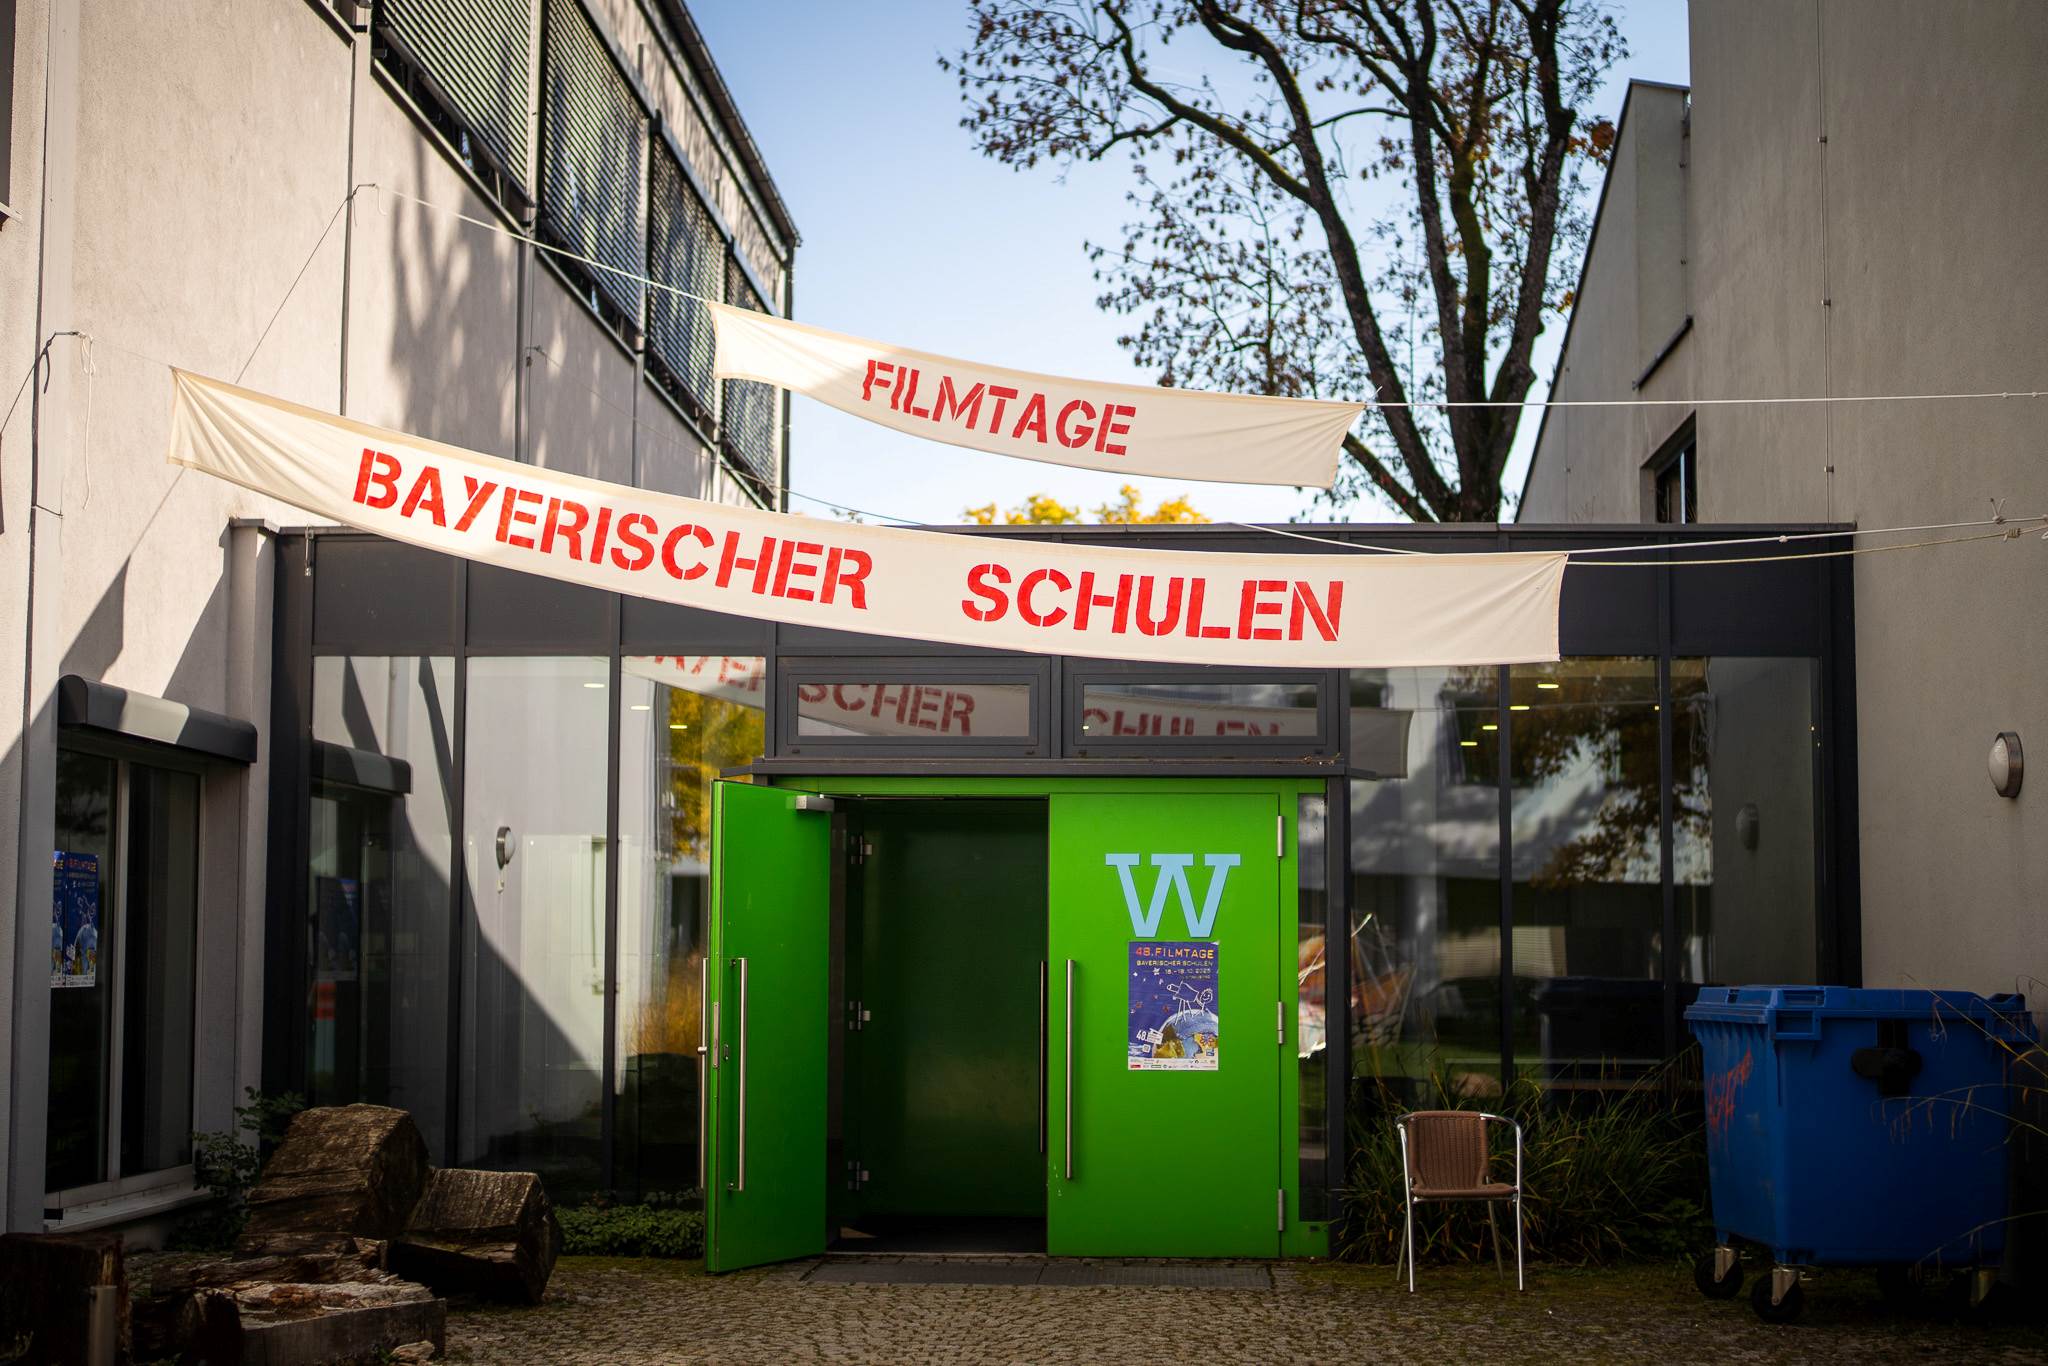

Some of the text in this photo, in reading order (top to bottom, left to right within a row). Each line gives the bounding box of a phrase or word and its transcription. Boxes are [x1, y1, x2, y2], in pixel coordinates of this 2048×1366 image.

[862, 359, 1137, 457] FILMTAGE
[353, 447, 1345, 642] BAYERISCHER SCHULEN
